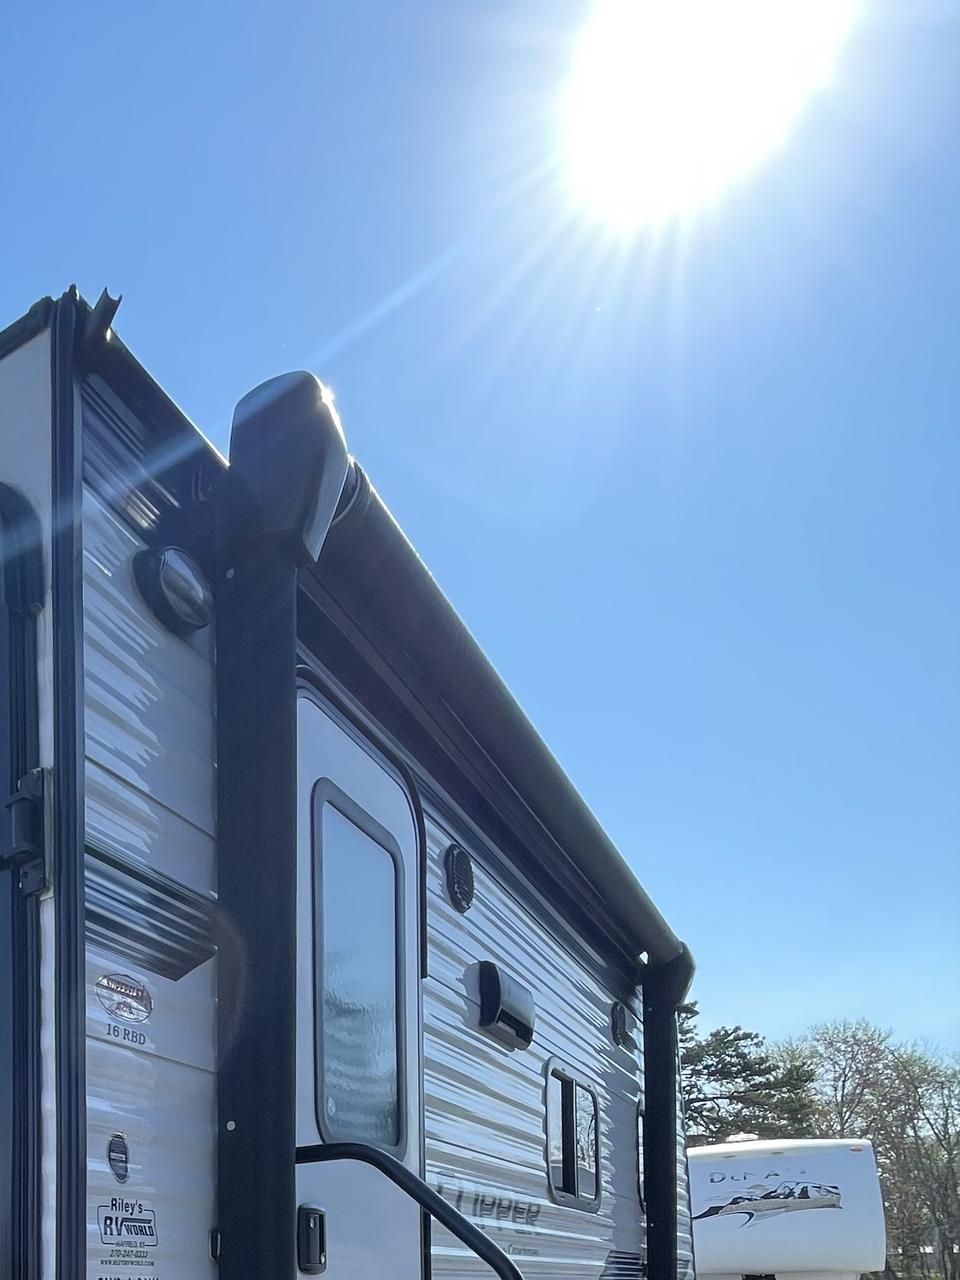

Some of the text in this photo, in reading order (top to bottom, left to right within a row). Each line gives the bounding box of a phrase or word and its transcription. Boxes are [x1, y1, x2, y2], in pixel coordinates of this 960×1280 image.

[106, 1023, 146, 1046] 16 RBD
[110, 1197, 143, 1216] Riley's
[123, 1224, 155, 1237] WORLD
